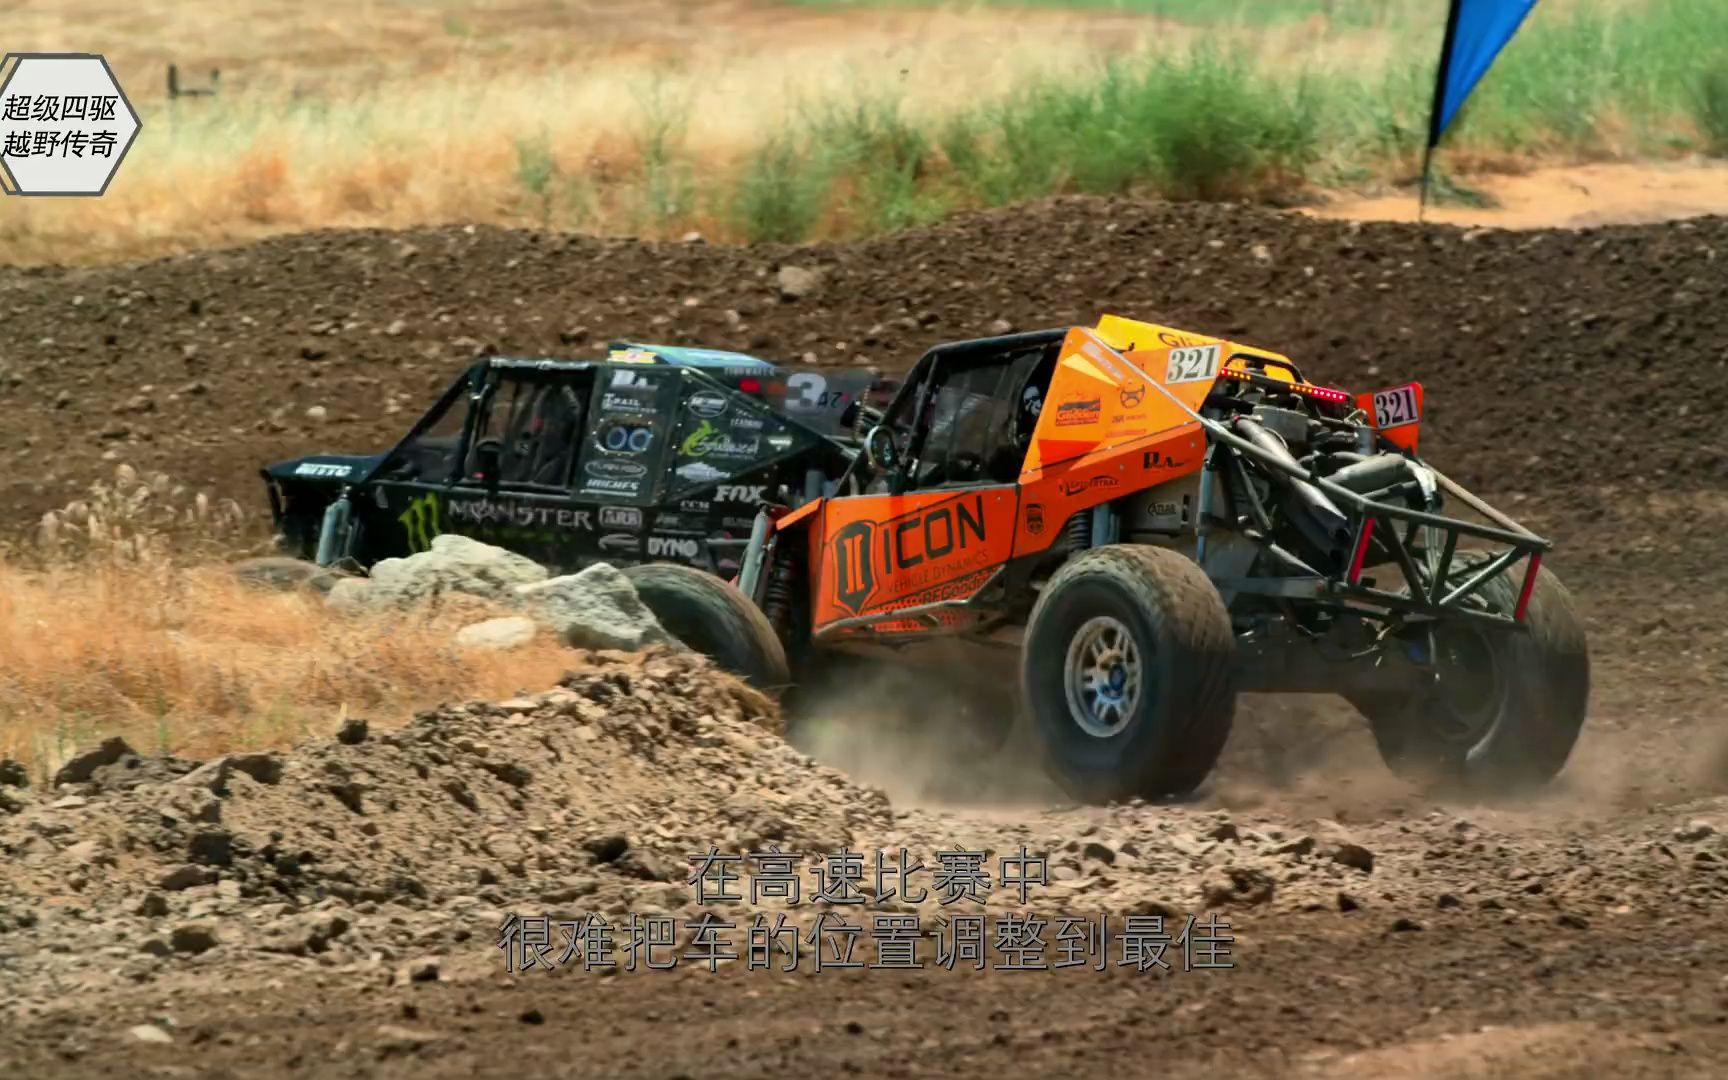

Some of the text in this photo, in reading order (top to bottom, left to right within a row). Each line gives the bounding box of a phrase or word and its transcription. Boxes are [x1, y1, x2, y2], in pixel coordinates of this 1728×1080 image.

[1167, 346, 1216, 382] 321
[1375, 389, 1418, 426] 321
[713, 485, 768, 503] FOX
[449, 498, 593, 531] MONSTER
[648, 537, 698, 556] DYNO
[884, 495, 986, 575] ICON
[887, 549, 990, 593] VEHICLE DYNAMICS
